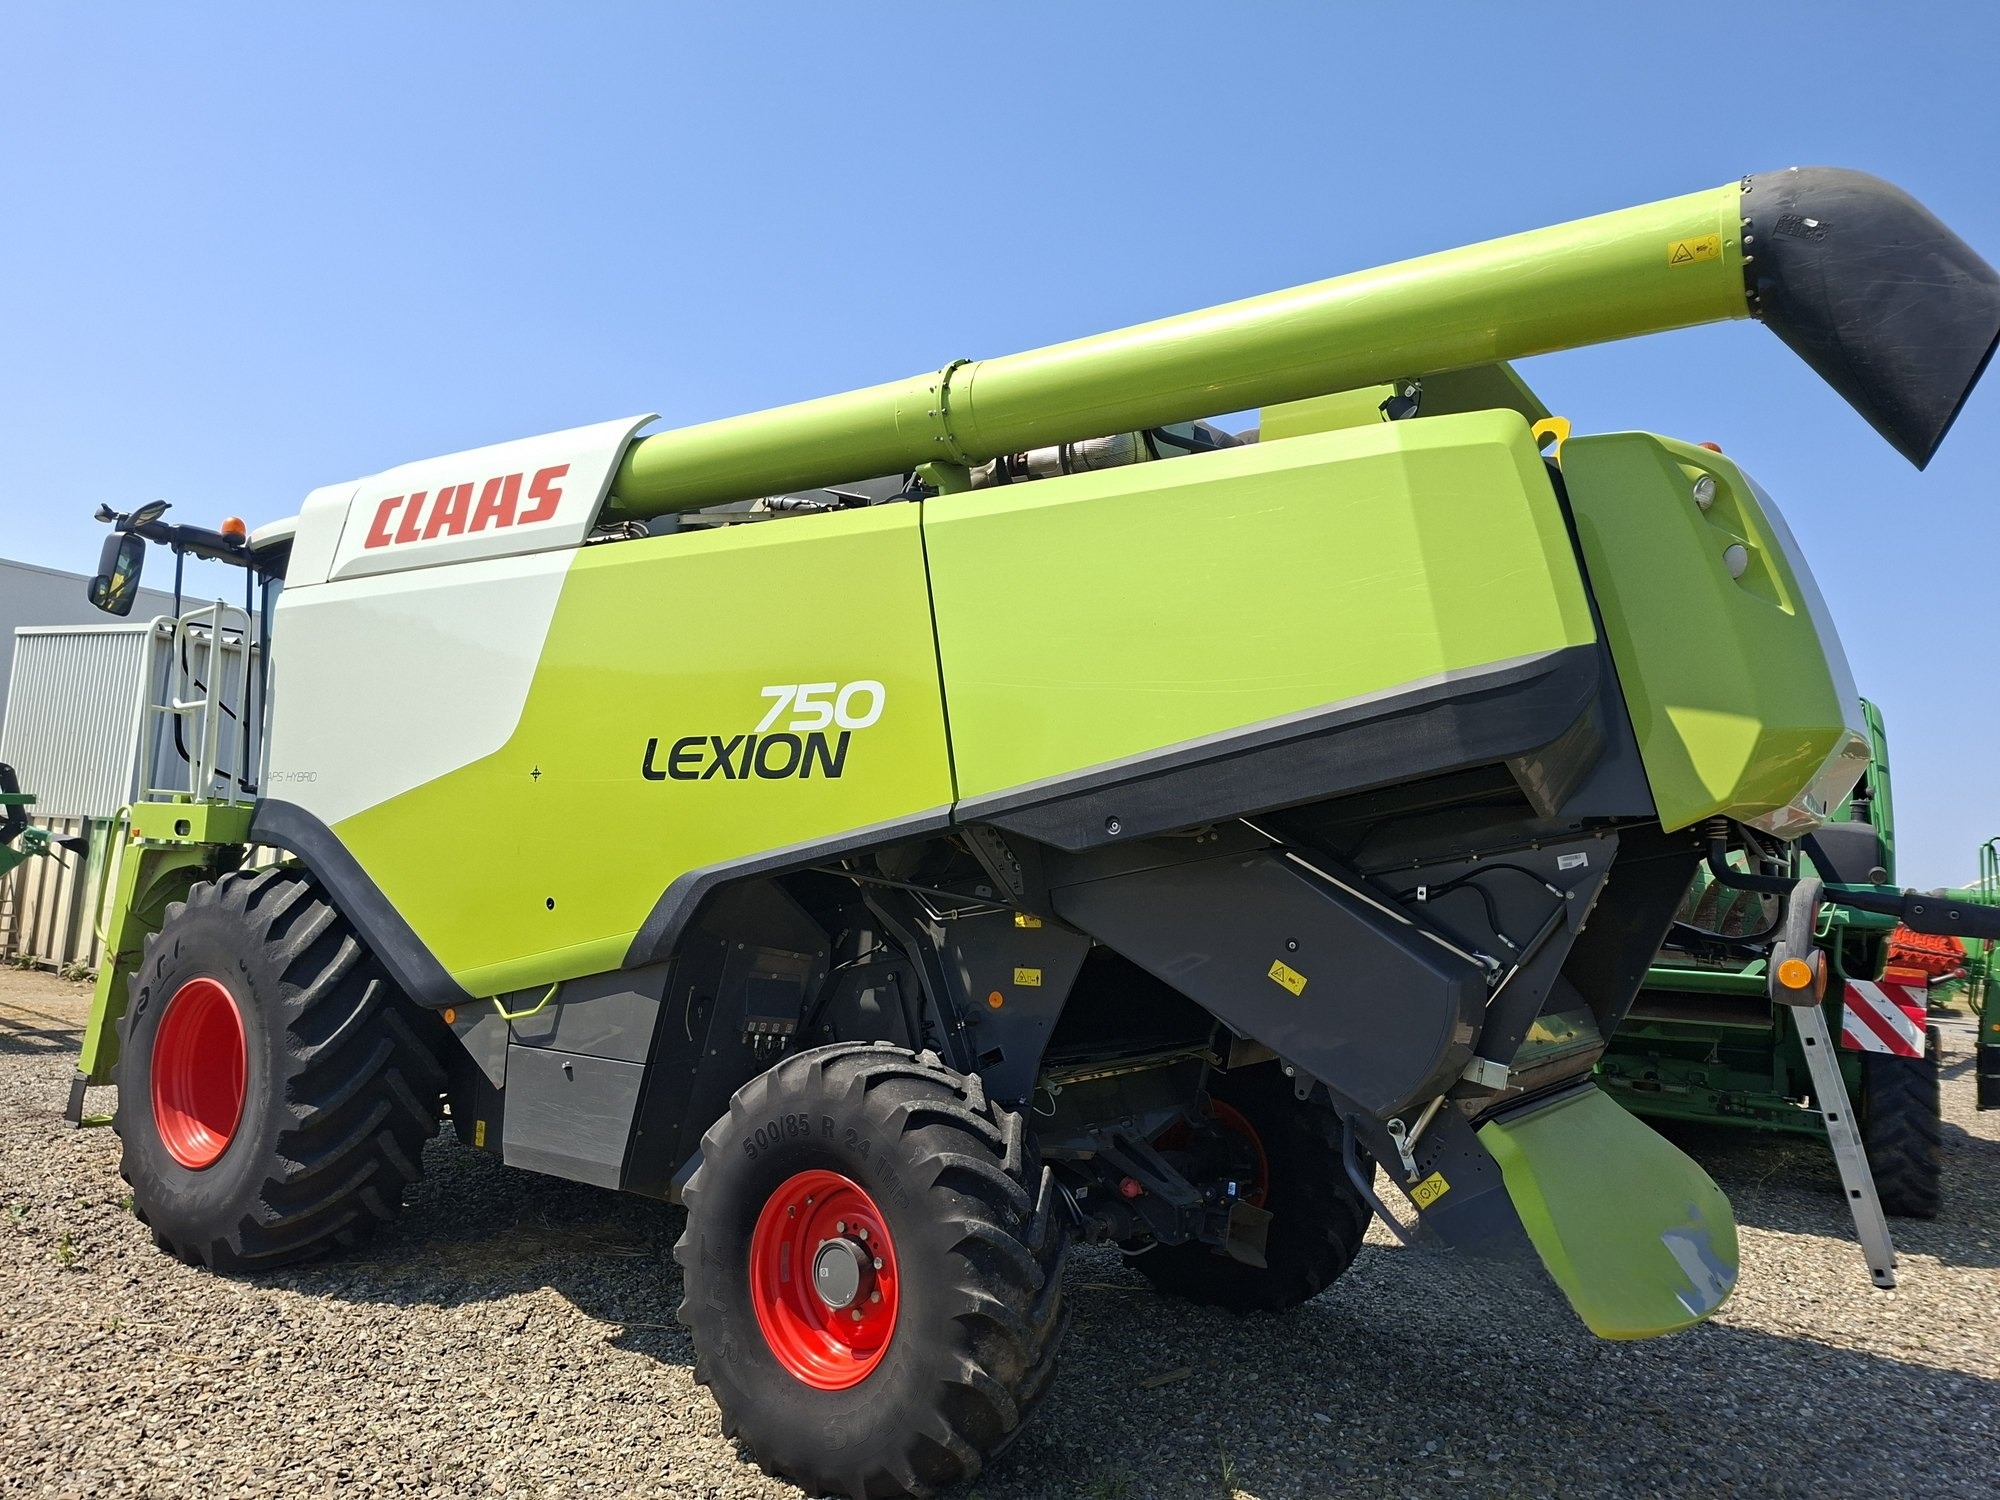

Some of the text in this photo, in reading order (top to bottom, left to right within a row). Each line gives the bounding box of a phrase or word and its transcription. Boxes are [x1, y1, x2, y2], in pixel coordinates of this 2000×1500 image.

[364, 463, 570, 549] CLAAS
[754, 680, 886, 732] 750
[642, 731, 851, 780] LEXION
[742, 1112, 811, 1160] 500/85
[821, 1114, 836, 1140] R
[845, 1127, 872, 1161] 24
